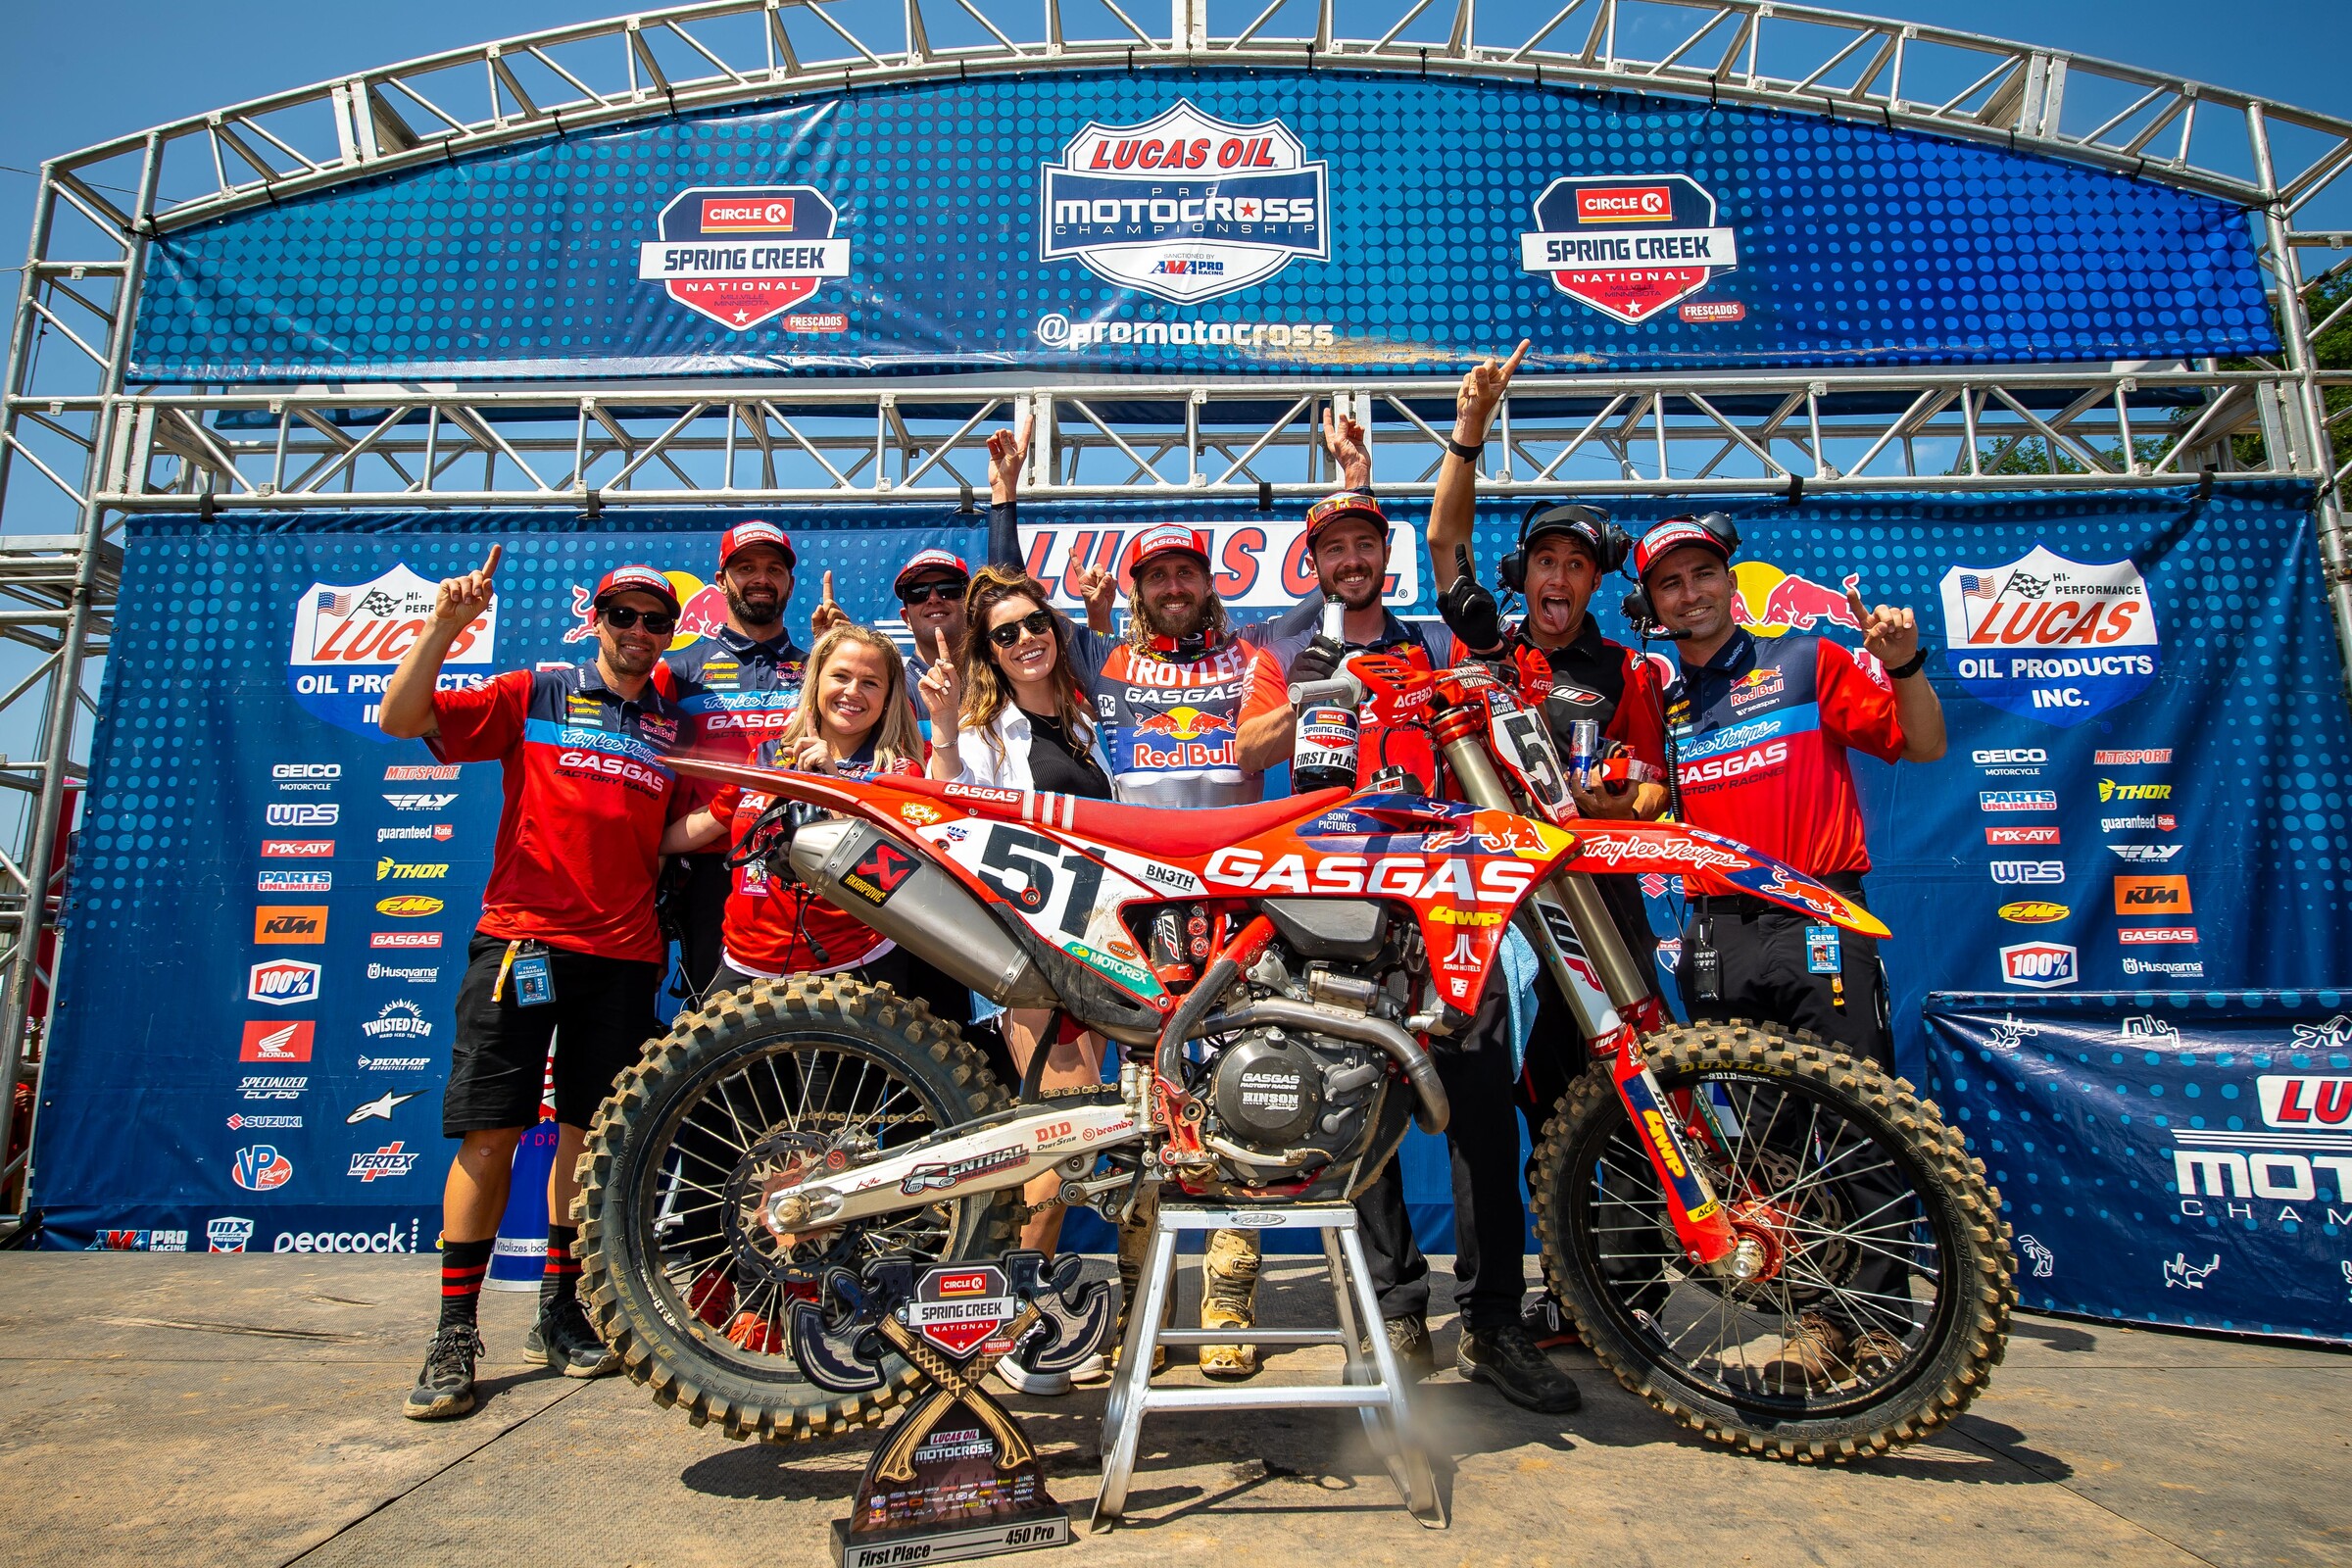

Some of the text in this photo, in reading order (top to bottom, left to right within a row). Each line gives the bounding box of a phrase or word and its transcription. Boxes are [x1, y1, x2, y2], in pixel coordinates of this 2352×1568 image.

[1089, 137, 1274, 170] LUCAS OIL
[1152, 187, 1218, 197] PRO
[1054, 197, 1315, 223] MOTOCROSS
[1585, 195, 1661, 211] CIRCLE K
[710, 206, 785, 220] CIRCLE K
[1055, 222, 1316, 235] CHAMPIONSHIP
[1546, 236, 1711, 263] SPRING CREEK
[663, 247, 825, 270] SPRING CREEK
[1148, 260, 1224, 275] AMA PRO
[1573, 271, 1690, 283] NATIONAL
[686, 281, 802, 292] NATIONAL
[1684, 305, 1739, 317] FRESCADOS
[789, 316, 843, 327] FRESCADOS
[1037, 313, 1334, 351] @promotocross
[1145, 538, 1193, 554] GASGAS
[1650, 532, 1702, 554] GASGAS
[2052, 572, 2071, 582] HI-
[406, 592, 422, 601] HI-
[2055, 585, 2142, 595] PERFORMANCE
[1968, 601, 2140, 645] LUCAS
[1199, 645, 1247, 685] LEE
[1958, 655, 2154, 678] OIL PRODUCTS
[296, 674, 339, 694] OIL
[1125, 681, 1243, 704] GASGAS
[1731, 678, 1785, 708] Red Bull
[2032, 688, 2090, 709] INC.
[704, 694, 760, 710] Troy Lee
[1492, 705, 1507, 715] LUCAS
[639, 719, 677, 743] Red Bull
[705, 730, 765, 740] FACTORY
[1303, 726, 1333, 735] SPRING
[1334, 727, 1357, 738] CREEK
[562, 729, 623, 751] Troy Lee
[1308, 735, 1351, 744] NATIONAL
[1687, 721, 1782, 759] Lee Designs
[1134, 739, 1238, 768] Red Bull
[1296, 752, 1327, 768] FIRST
[1972, 749, 2046, 763] GEICO
[271, 763, 341, 778] GEICO
[553, 768, 620, 785] FACTORY
[559, 751, 663, 793] GASGAS
[1729, 766, 1785, 789] RACING
[944, 783, 1020, 804] GASGAS
[1980, 791, 2057, 803] PARTS
[2117, 784, 2172, 800] THOR
[390, 793, 460, 808] FLY
[1981, 802, 2057, 811] UNLIMITED
[267, 804, 339, 826] WPS
[1328, 812, 1348, 822] SONY
[1318, 820, 1357, 833] PICTURES
[2100, 814, 2175, 833] guaranteed Rate
[376, 825, 452, 843] guaranteed Rate
[1584, 835, 1627, 866] Troy
[1626, 835, 1661, 858] Lee
[1662, 838, 1751, 869] Designs
[2115, 845, 2183, 858] FLY
[258, 870, 332, 883] PARTS
[393, 863, 449, 879] THOR
[1146, 864, 1196, 890] BN3TH
[1204, 847, 1536, 904] GASGAS
[1990, 860, 2066, 884] WPS
[258, 882, 331, 892] UNLIMITED
[845, 874, 887, 904] AKRAPOVIC
[977, 823, 1106, 940] 51
[2124, 885, 2179, 905] KTM
[376, 899, 444, 912] FMF
[1998, 904, 2070, 918] FMF
[263, 915, 318, 934] KTM
[1428, 906, 1502, 927] 4WP
[372, 934, 440, 946] GASGAS
[2120, 930, 2194, 942] GASGAS
[380, 966, 438, 979] Husqvarna
[1089, 953, 1150, 985] MOTOREX
[2012, 953, 2069, 977] 100%
[2138, 961, 2203, 973] Husqvarna
[260, 970, 311, 995] 100%
[362, 1017, 432, 1037] TWISTED TEA
[1595, 1033, 1618, 1049] WP
[370, 1057, 431, 1066] DUNLOP
[1678, 1059, 1792, 1077] DUNLOP
[241, 1076, 309, 1089] SPECIALIZED
[1242, 1073, 1300, 1085] GASGAS
[244, 1090, 299, 1100] turbo
[1242, 1092, 1299, 1104] HINSON
[244, 1115, 303, 1128] SUZUKI
[1097, 1119, 1135, 1137] brembo
[236, 1145, 277, 1191] VP
[350, 1152, 418, 1169] VERTEX
[259, 1166, 292, 1183] Racing
[84, 1229, 189, 1251] AMA PRO
[273, 1222, 407, 1253] peacock
[149, 1244, 187, 1252] RACING
[497, 1240, 528, 1252] Vitalizes
[943, 1280, 971, 1290] CIRCLE
[921, 1300, 1003, 1321] SPRING CREEK
[932, 1322, 991, 1333] NATIONAL
[984, 1341, 1012, 1349] FRESCADOS
[932, 1429, 978, 1444] LUCAS OIL
[914, 1443, 994, 1461] MOTOCROSS
[914, 1452, 994, 1466] CHAMPIONSHIP
[1004, 1525, 1055, 1546] 450 Pro
[858, 1544, 931, 1568] First Place
